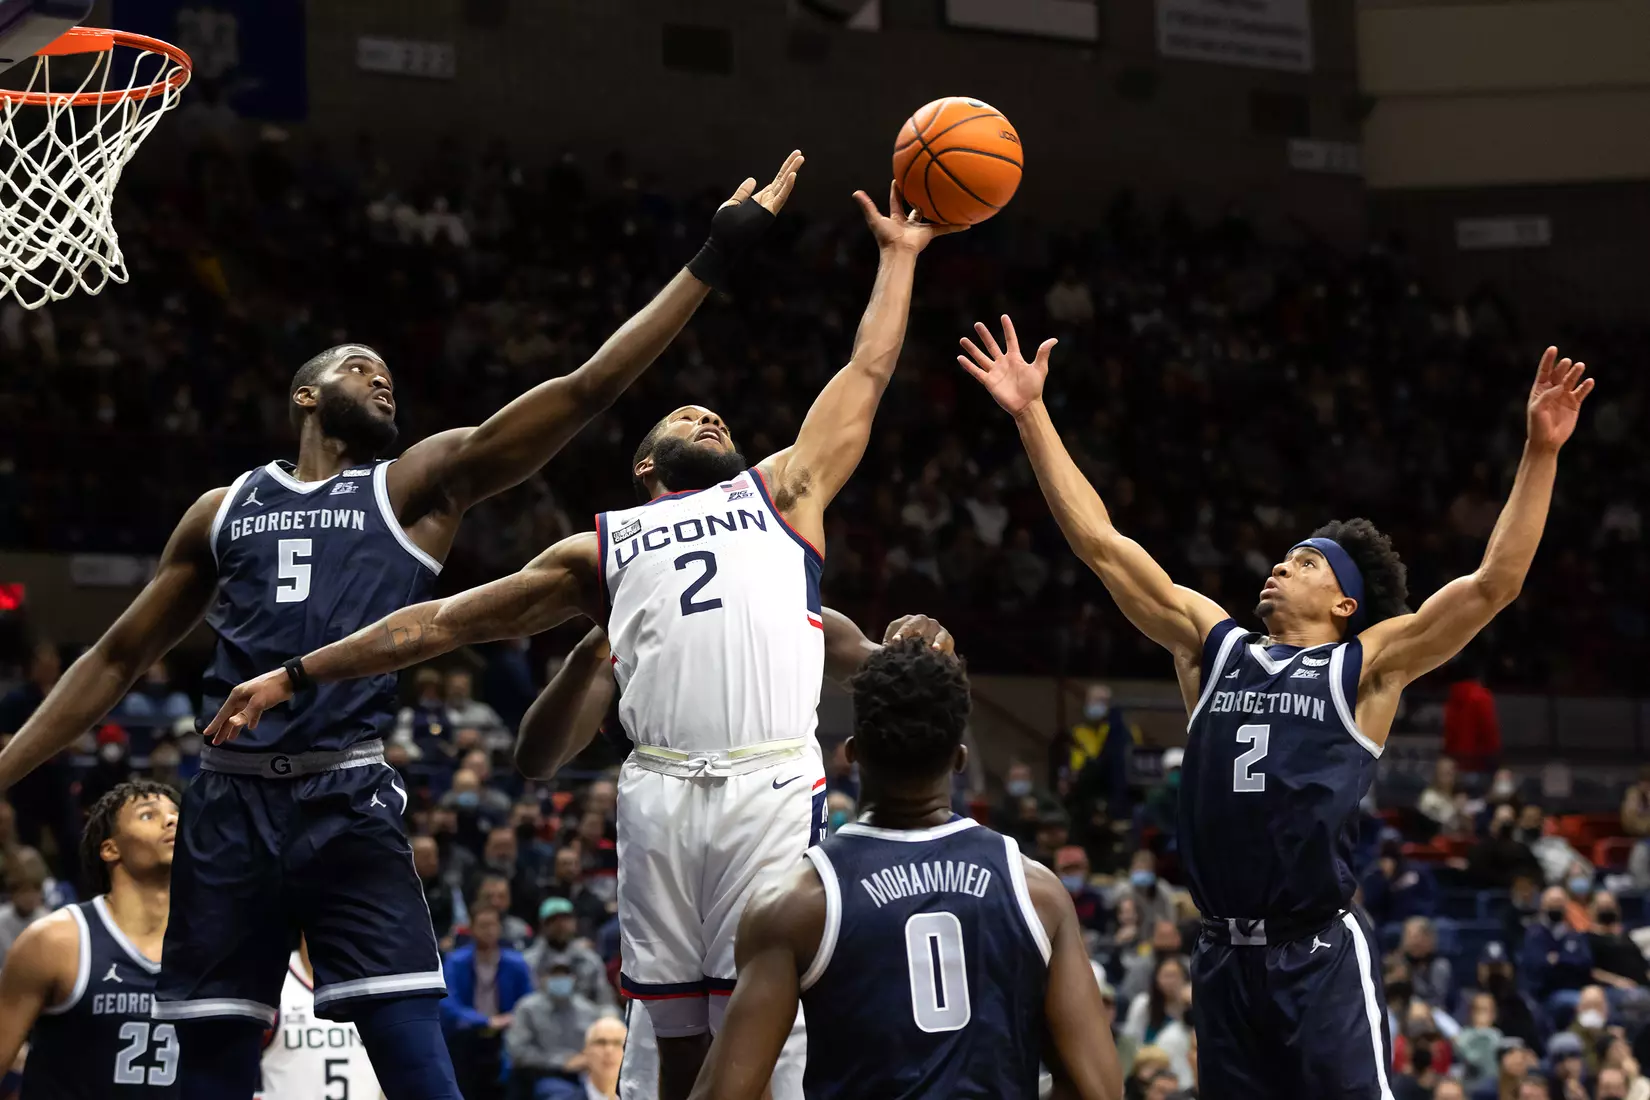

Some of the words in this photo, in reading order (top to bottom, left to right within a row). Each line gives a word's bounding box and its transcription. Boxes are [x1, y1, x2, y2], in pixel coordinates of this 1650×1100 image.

[728, 492, 755, 501] EAST
[230, 509, 366, 541] GEORGETOWN
[614, 509, 768, 570] UCONN
[275, 538, 313, 603] 5
[673, 550, 723, 617] 2
[1209, 690, 1326, 722] EORGETOWN
[270, 755, 292, 775] G
[1233, 724, 1271, 793] 2
[860, 860, 992, 909] MOHAMMED
[905, 911, 971, 1034] 0
[113, 1021, 180, 1087] 23
[324, 1058, 351, 1100] 5
